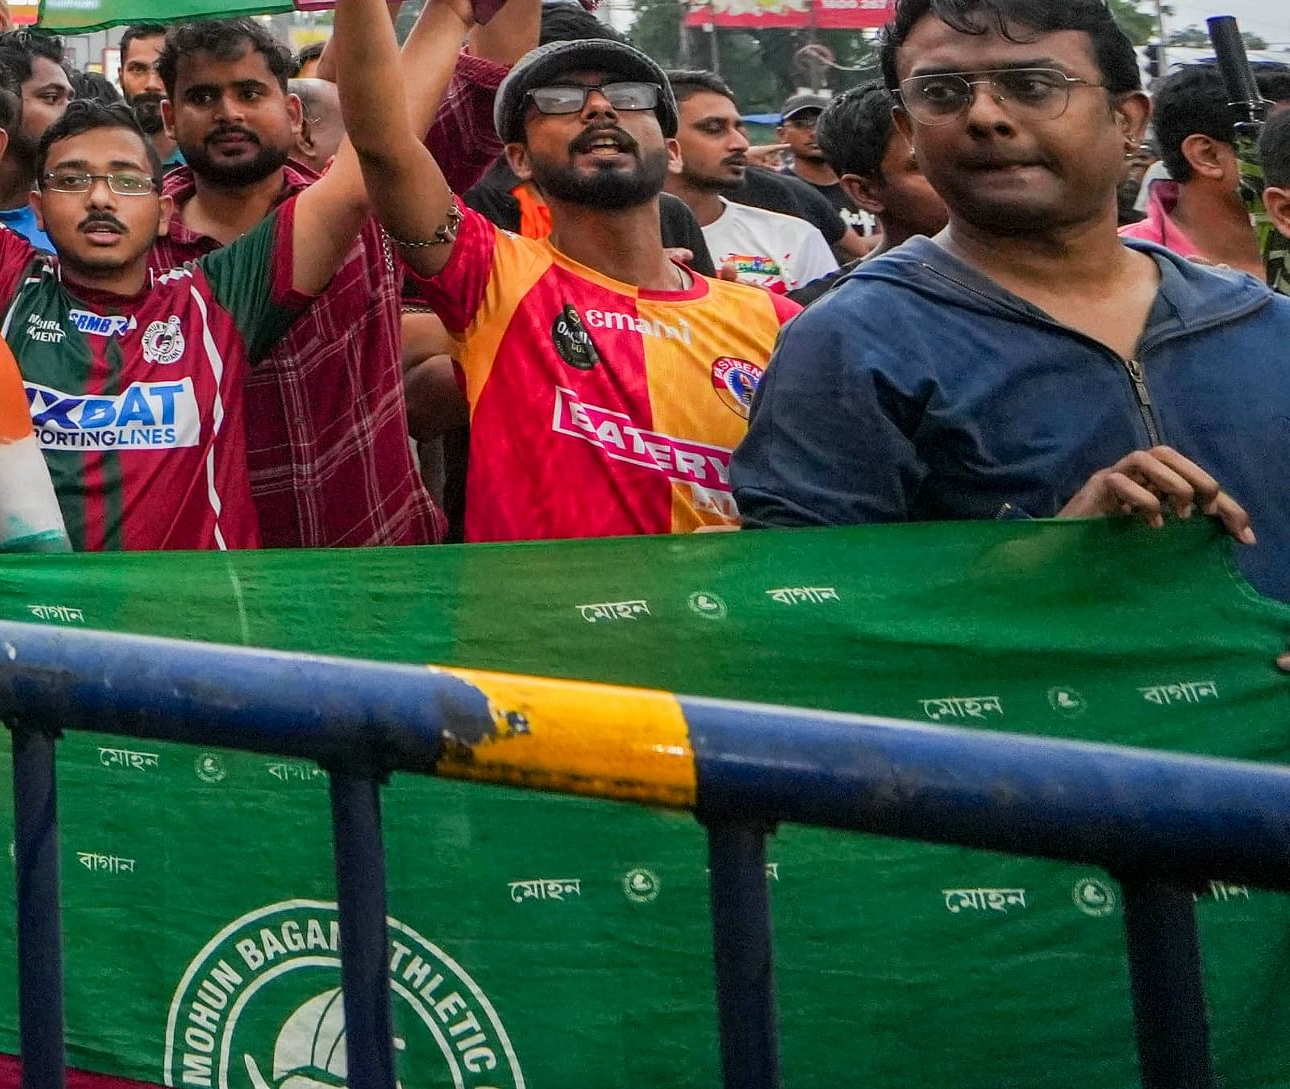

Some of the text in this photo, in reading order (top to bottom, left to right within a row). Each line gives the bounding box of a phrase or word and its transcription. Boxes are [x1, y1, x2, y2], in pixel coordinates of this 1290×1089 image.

[27, 605, 85, 623] বাগান
[575, 586, 841, 622] মোহন বাগান
[919, 681, 1219, 720] মোহন বাগান
[98, 747, 160, 772] মোহন
[76, 851, 136, 874] বাগান
[507, 878, 581, 902] মোহন
[941, 887, 1026, 914] মোহন
[182, 959, 244, 1087] MOHUN
